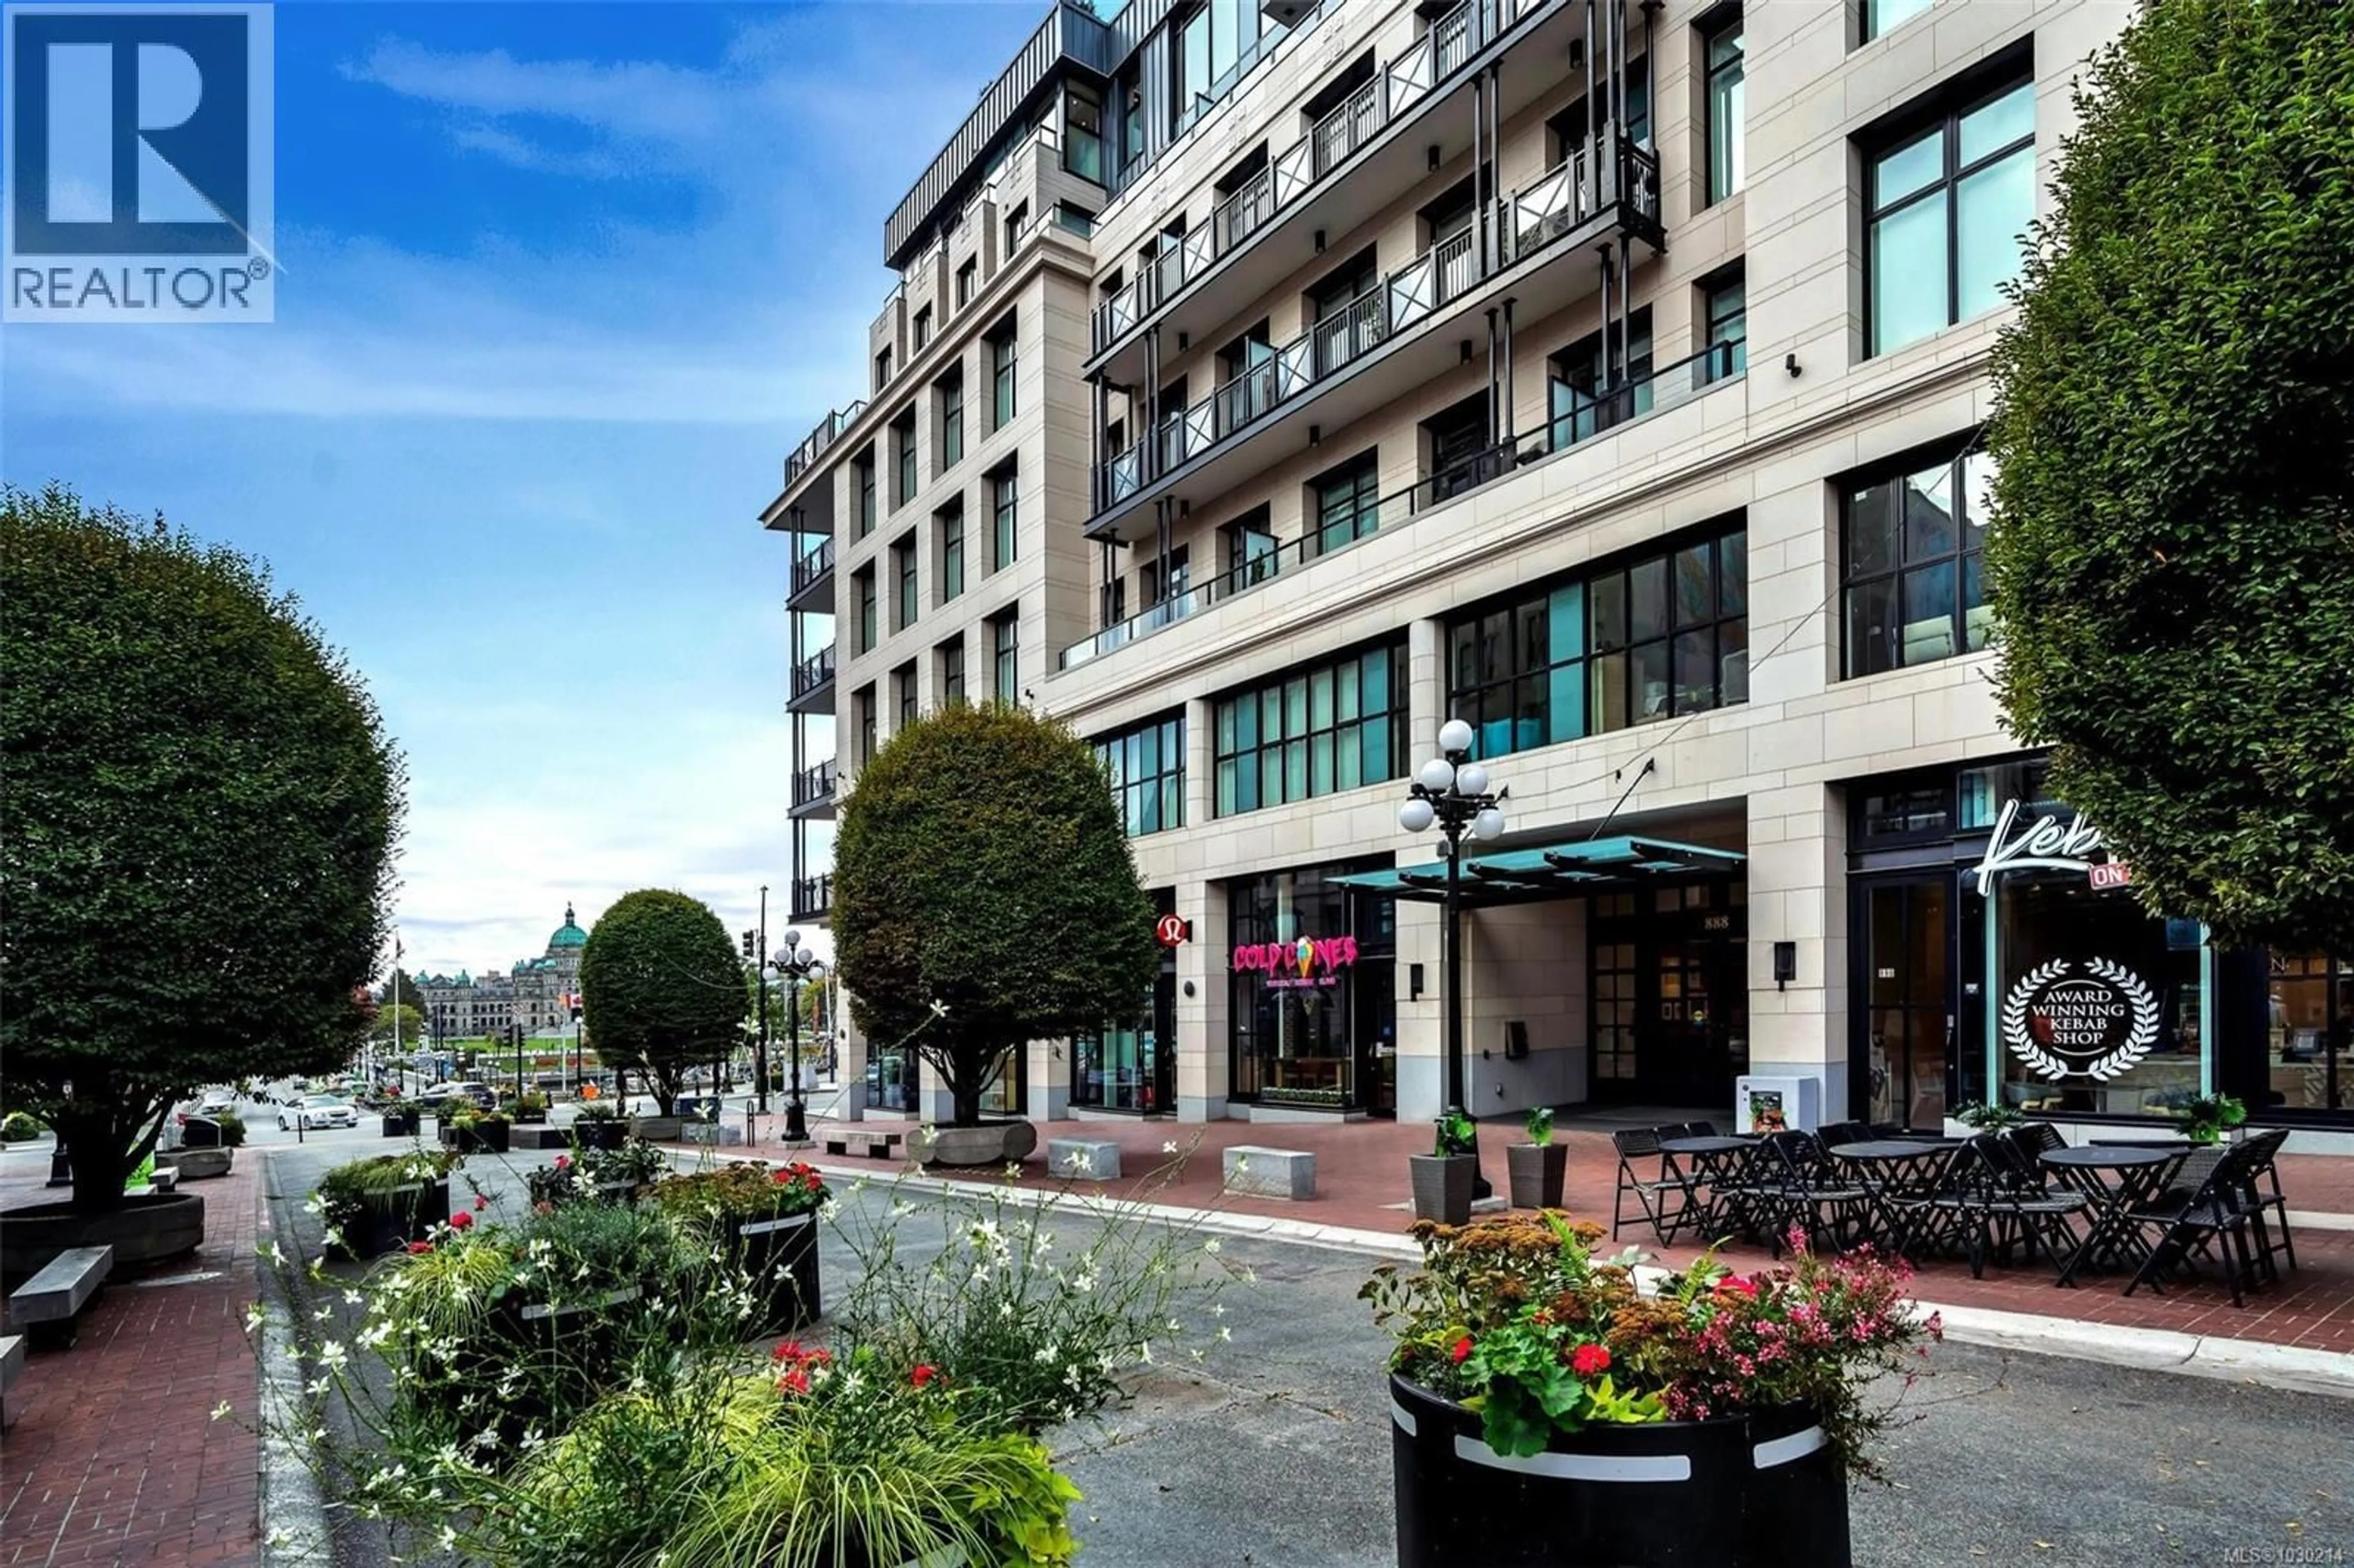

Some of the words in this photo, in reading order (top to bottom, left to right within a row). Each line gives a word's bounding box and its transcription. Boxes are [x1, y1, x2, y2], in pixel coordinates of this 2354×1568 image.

[1973, 799, 2109, 897] Keb
[1705, 916, 1729, 930] 888
[1234, 943, 1282, 976] COLD
[2043, 991, 2112, 1003] AWARD
[2032, 1004, 2125, 1017] WINNING
[2050, 1018, 2108, 1030] KEBAB
[2054, 1032, 2103, 1045] SHOP
